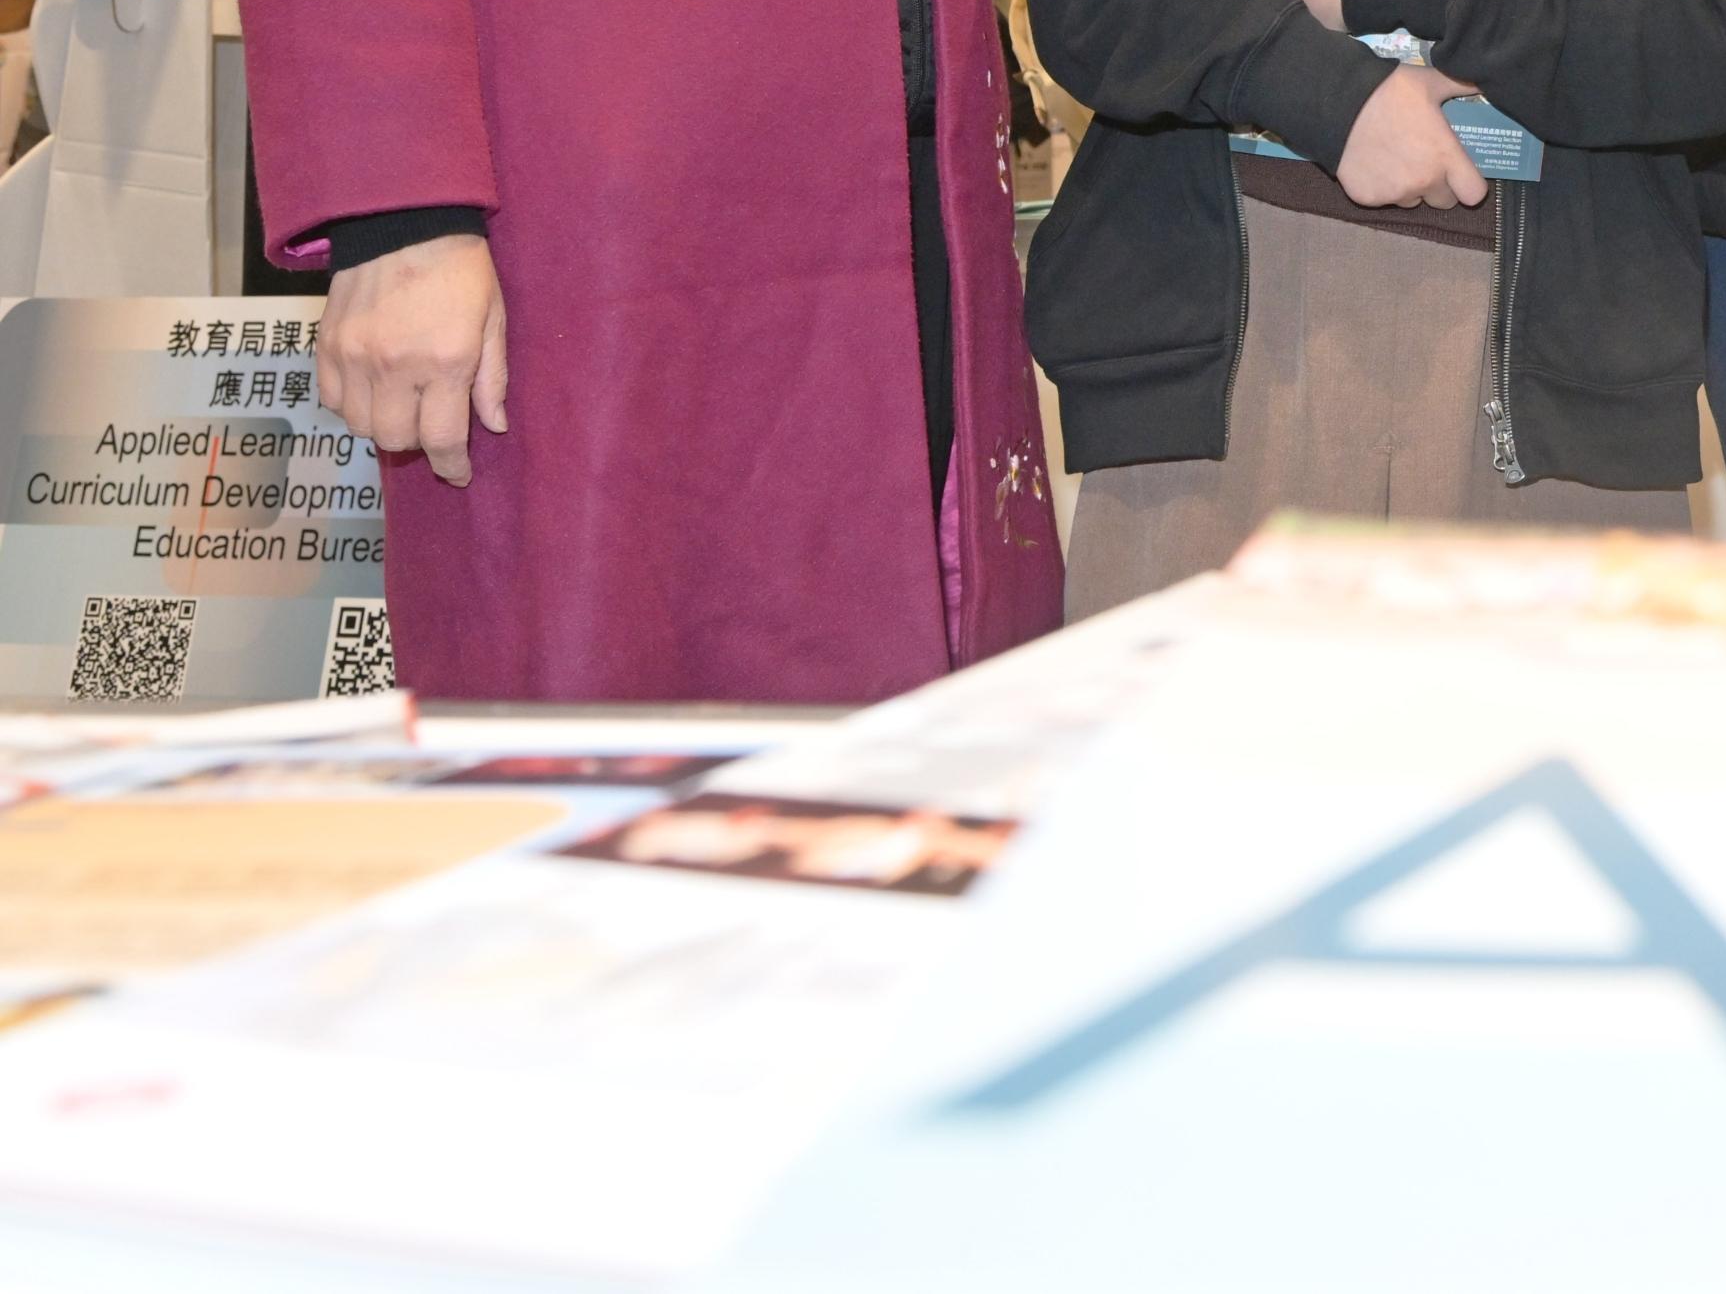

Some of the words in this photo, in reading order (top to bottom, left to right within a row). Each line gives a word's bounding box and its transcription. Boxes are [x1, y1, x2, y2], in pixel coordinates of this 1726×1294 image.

[209, 370, 322, 409] 應用學
[96, 422, 213, 463] Applied
[221, 425, 354, 466] Learning
[27, 472, 190, 506] Curriculum
[201, 475, 382, 518] Developme
[133, 525, 285, 561] Education
[297, 528, 385, 563] Burea
